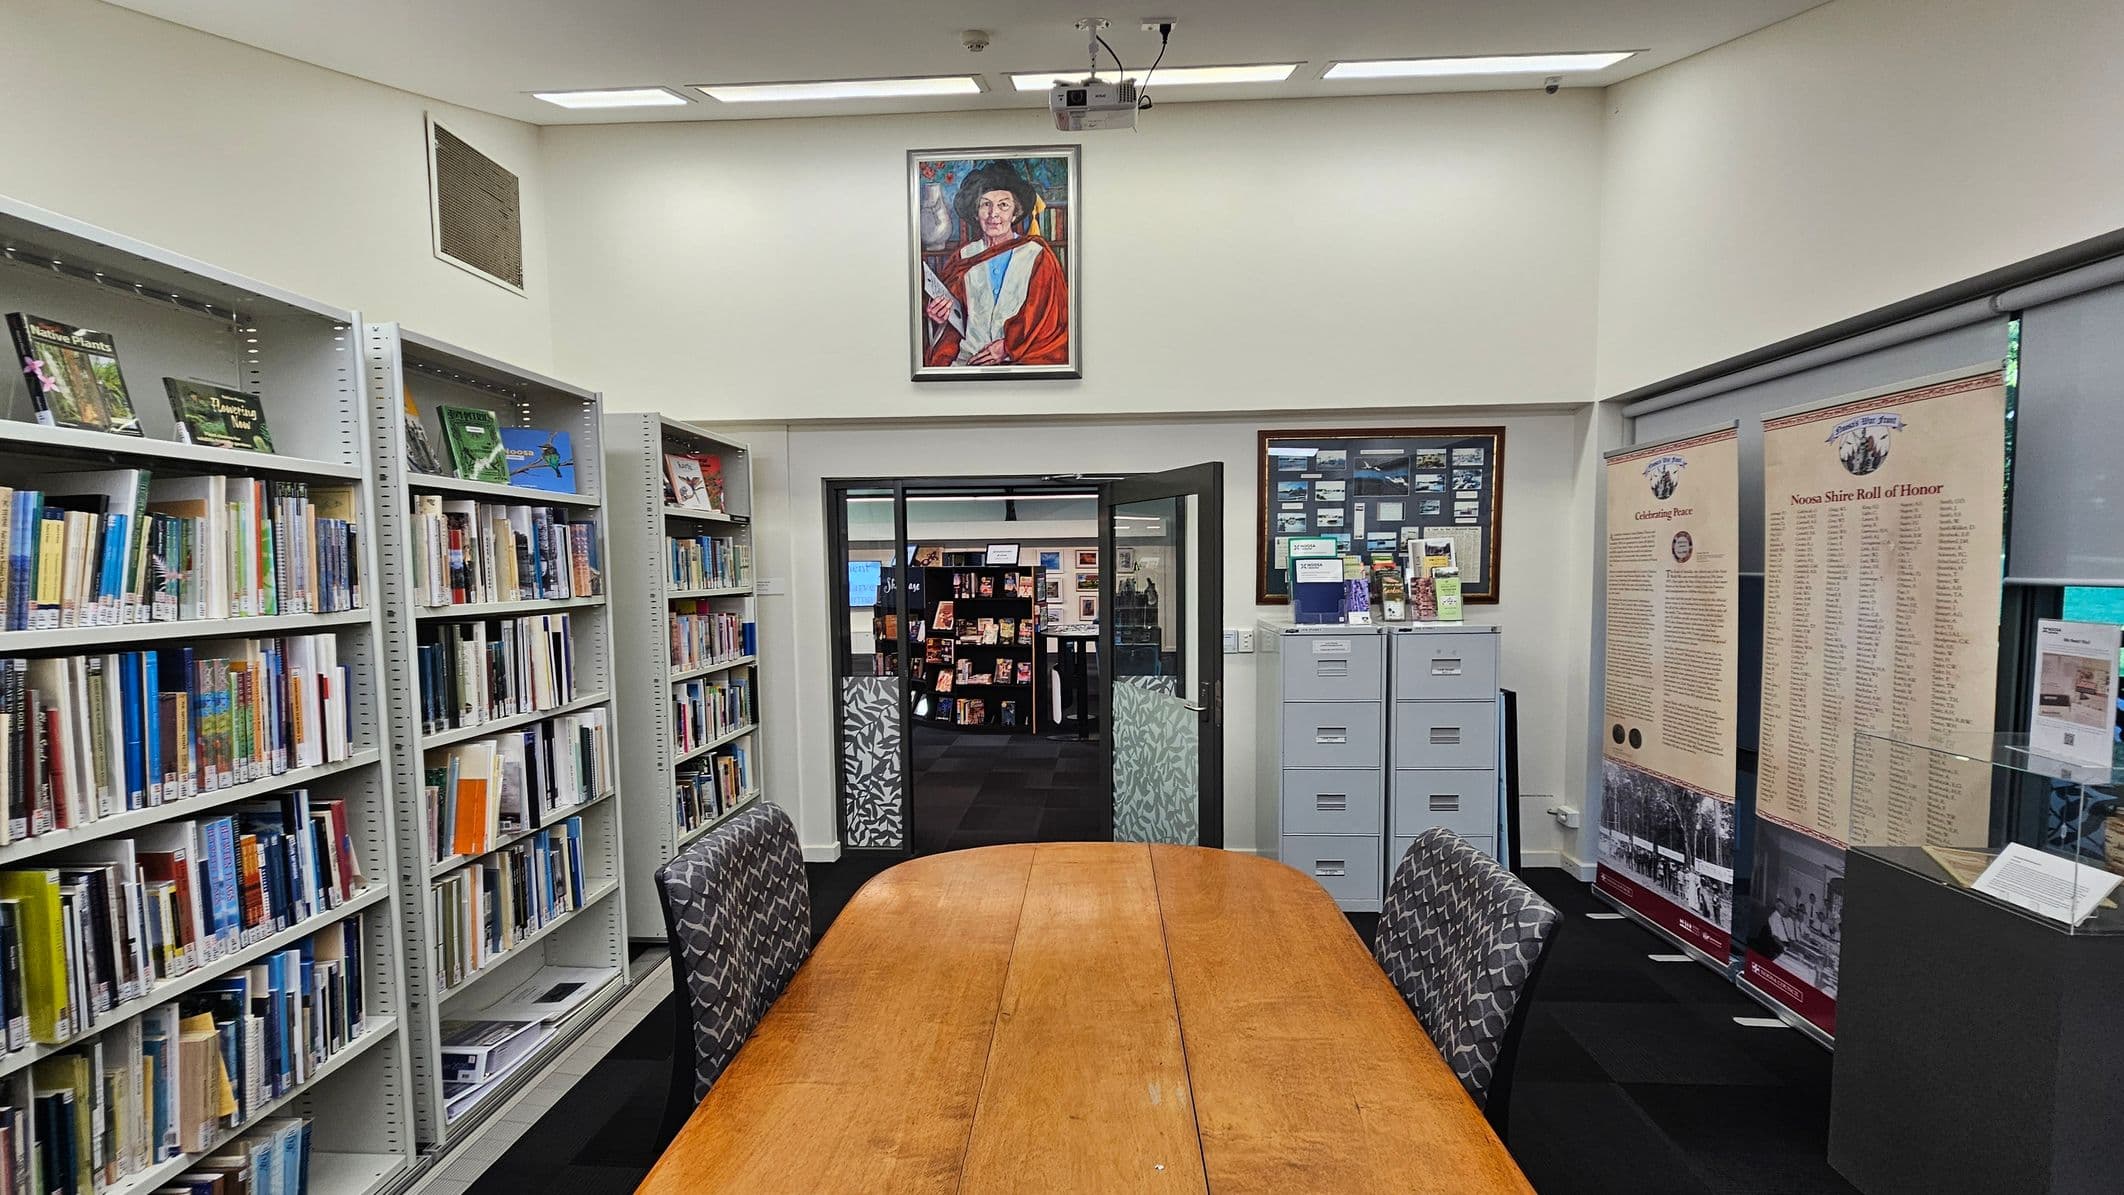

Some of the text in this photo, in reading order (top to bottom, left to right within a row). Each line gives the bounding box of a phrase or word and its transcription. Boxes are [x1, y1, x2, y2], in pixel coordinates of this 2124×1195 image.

[30, 323, 73, 344] Native
[74, 336, 112, 353] Plants
[210, 397, 257, 421] Flowering
[1790, 483, 1944, 506] Noosa Shire Roll of Honor
[1635, 507, 1693, 521] Celebrating Peace
